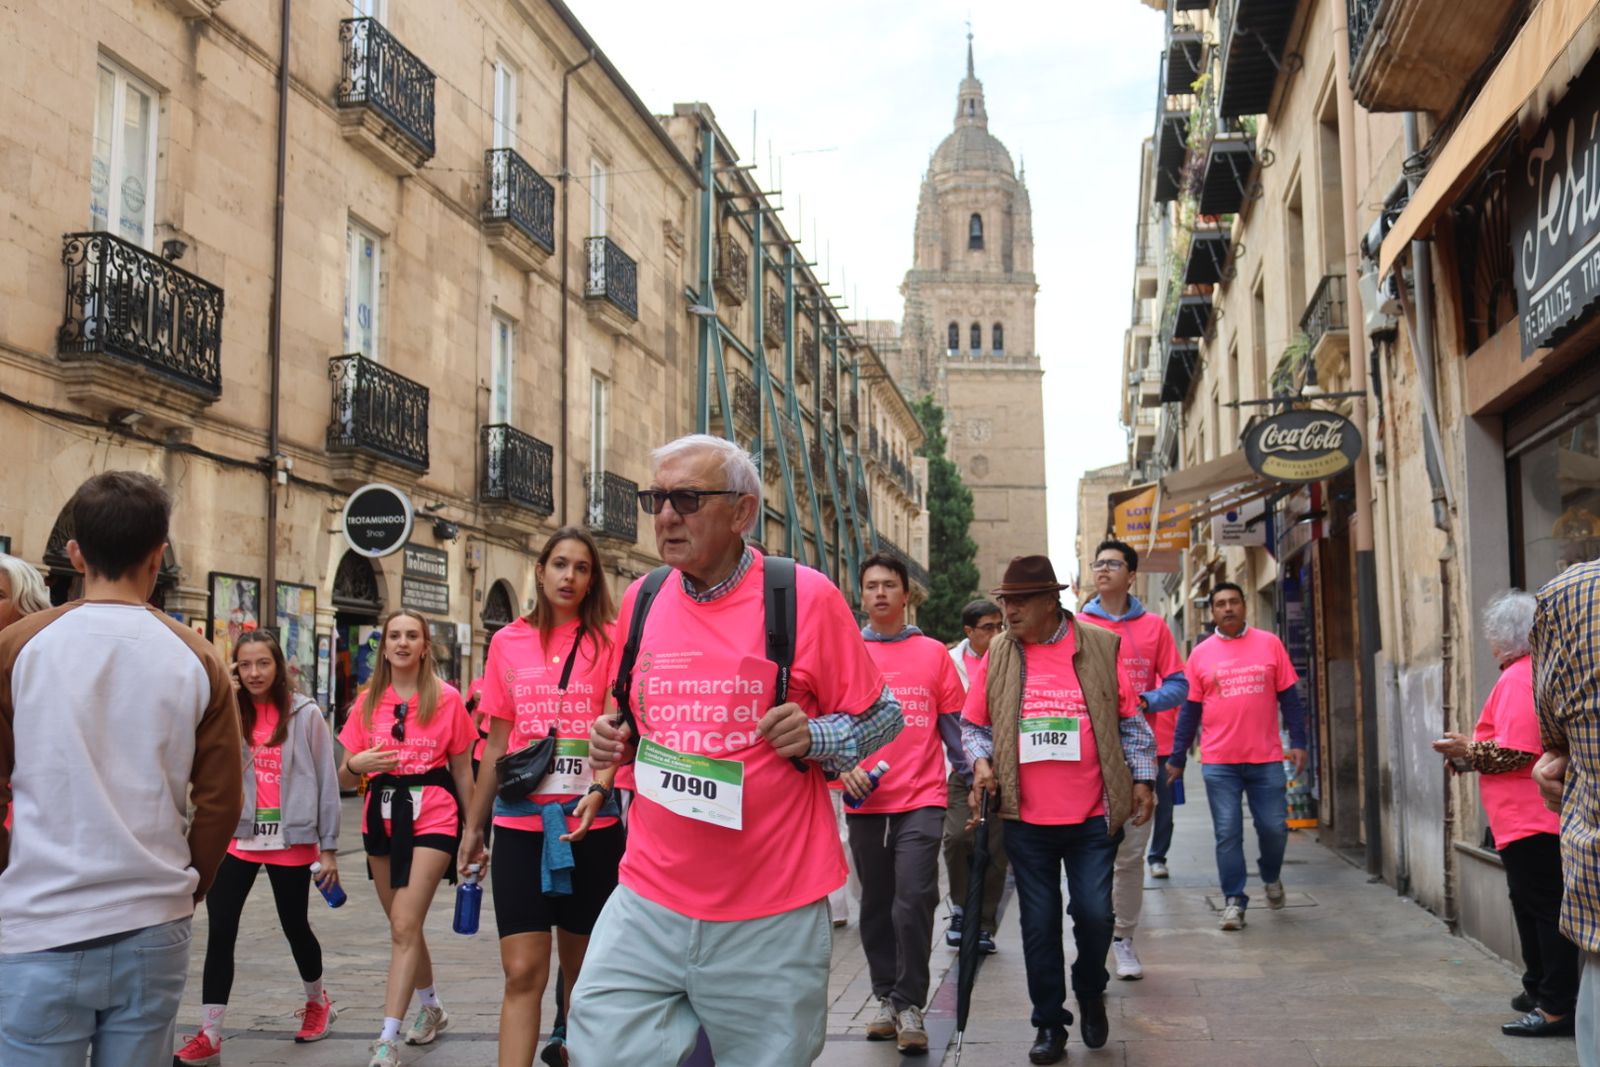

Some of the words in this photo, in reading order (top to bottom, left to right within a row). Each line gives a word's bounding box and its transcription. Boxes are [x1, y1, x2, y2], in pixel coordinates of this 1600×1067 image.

[1525, 279, 1572, 344] REGALOS
[1259, 420, 1344, 453] Coca-Cola
[347, 515, 405, 525] TROTAMUNDOS
[366, 530, 385, 538] Shop
[1122, 656, 1151, 666] archa
[515, 684, 532, 697] En
[648, 677, 672, 695] En
[679, 675, 764, 694] marcha
[517, 698, 573, 715] contra
[575, 697, 592, 713] el
[649, 700, 729, 722] contra
[733, 699, 761, 722] el
[375, 736, 388, 746] En
[1030, 732, 1067, 746] 11482
[660, 770, 717, 800] 7090
[253, 823, 279, 836] 0477
